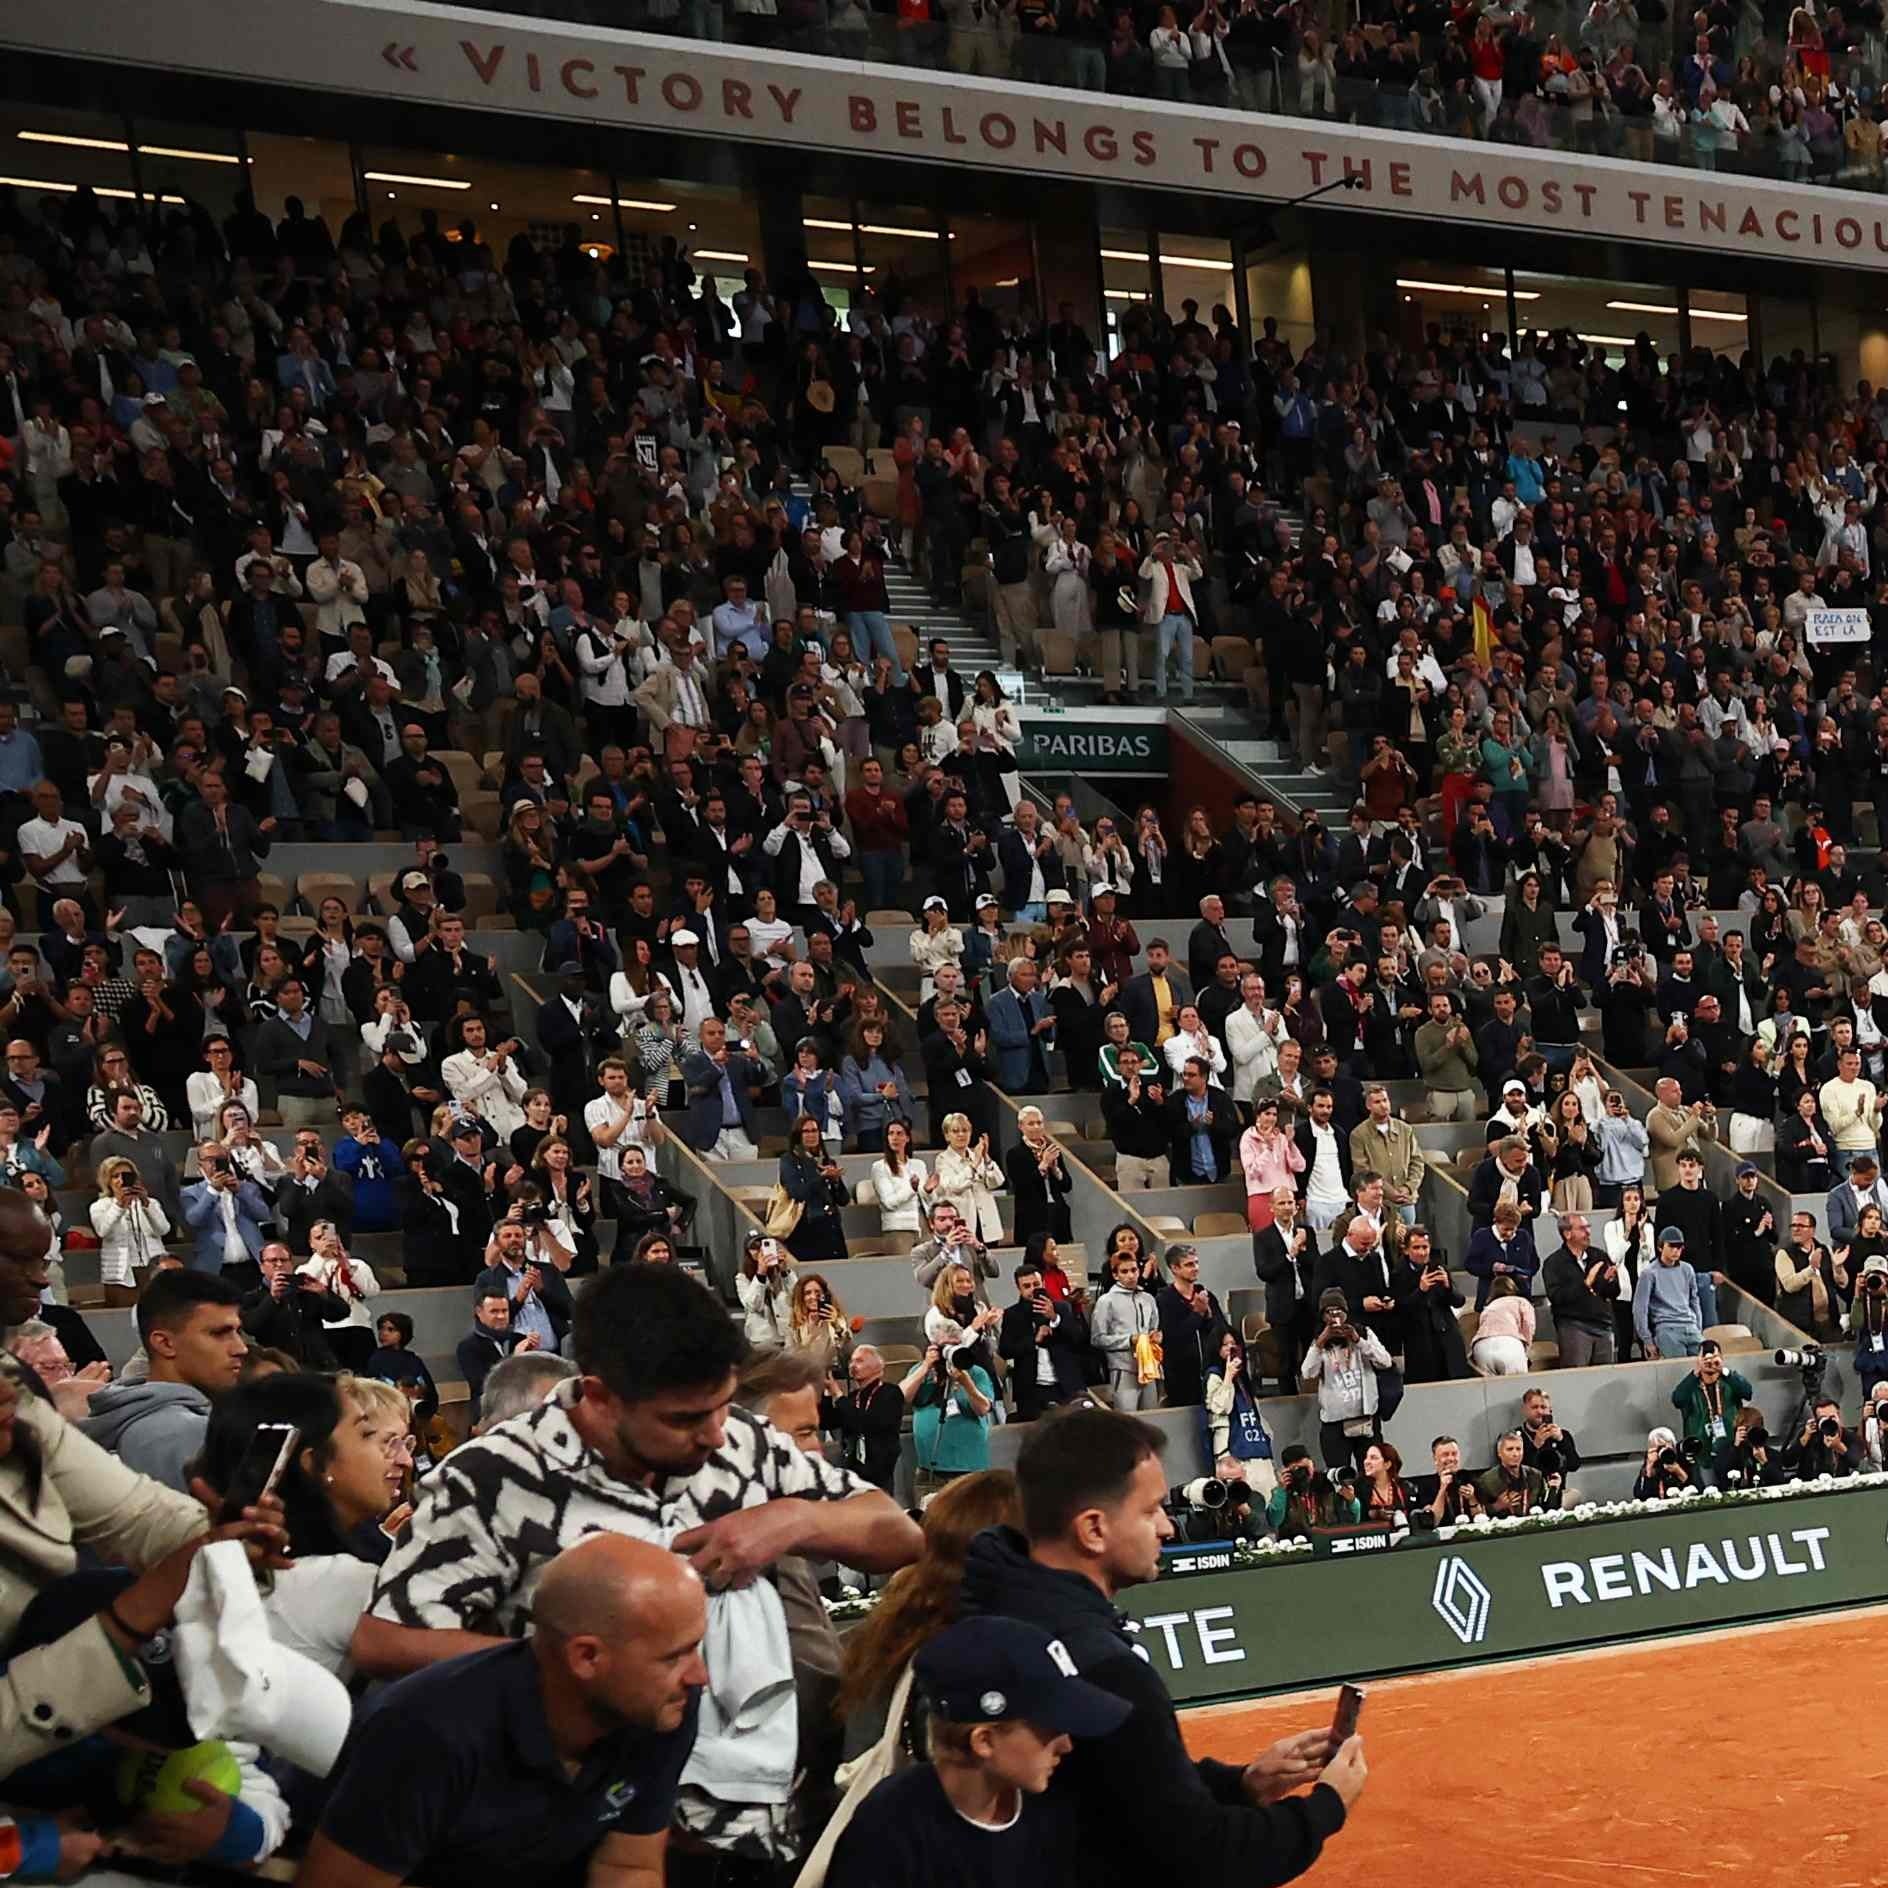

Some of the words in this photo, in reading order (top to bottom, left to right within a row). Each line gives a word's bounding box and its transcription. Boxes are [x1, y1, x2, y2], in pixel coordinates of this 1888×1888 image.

[460, 40, 801, 123] VICTORY
[848, 95, 1157, 166] BELONGS
[1193, 137, 1267, 177] TO
[1302, 151, 1412, 196] THE
[1450, 171, 1598, 218] MOST
[1033, 734, 1150, 757] PARIBAS
[1355, 1535, 1386, 1551] ISDIN
[1197, 1554, 1230, 1570] ISDIN
[1541, 1528, 1830, 1608] RENAULT
